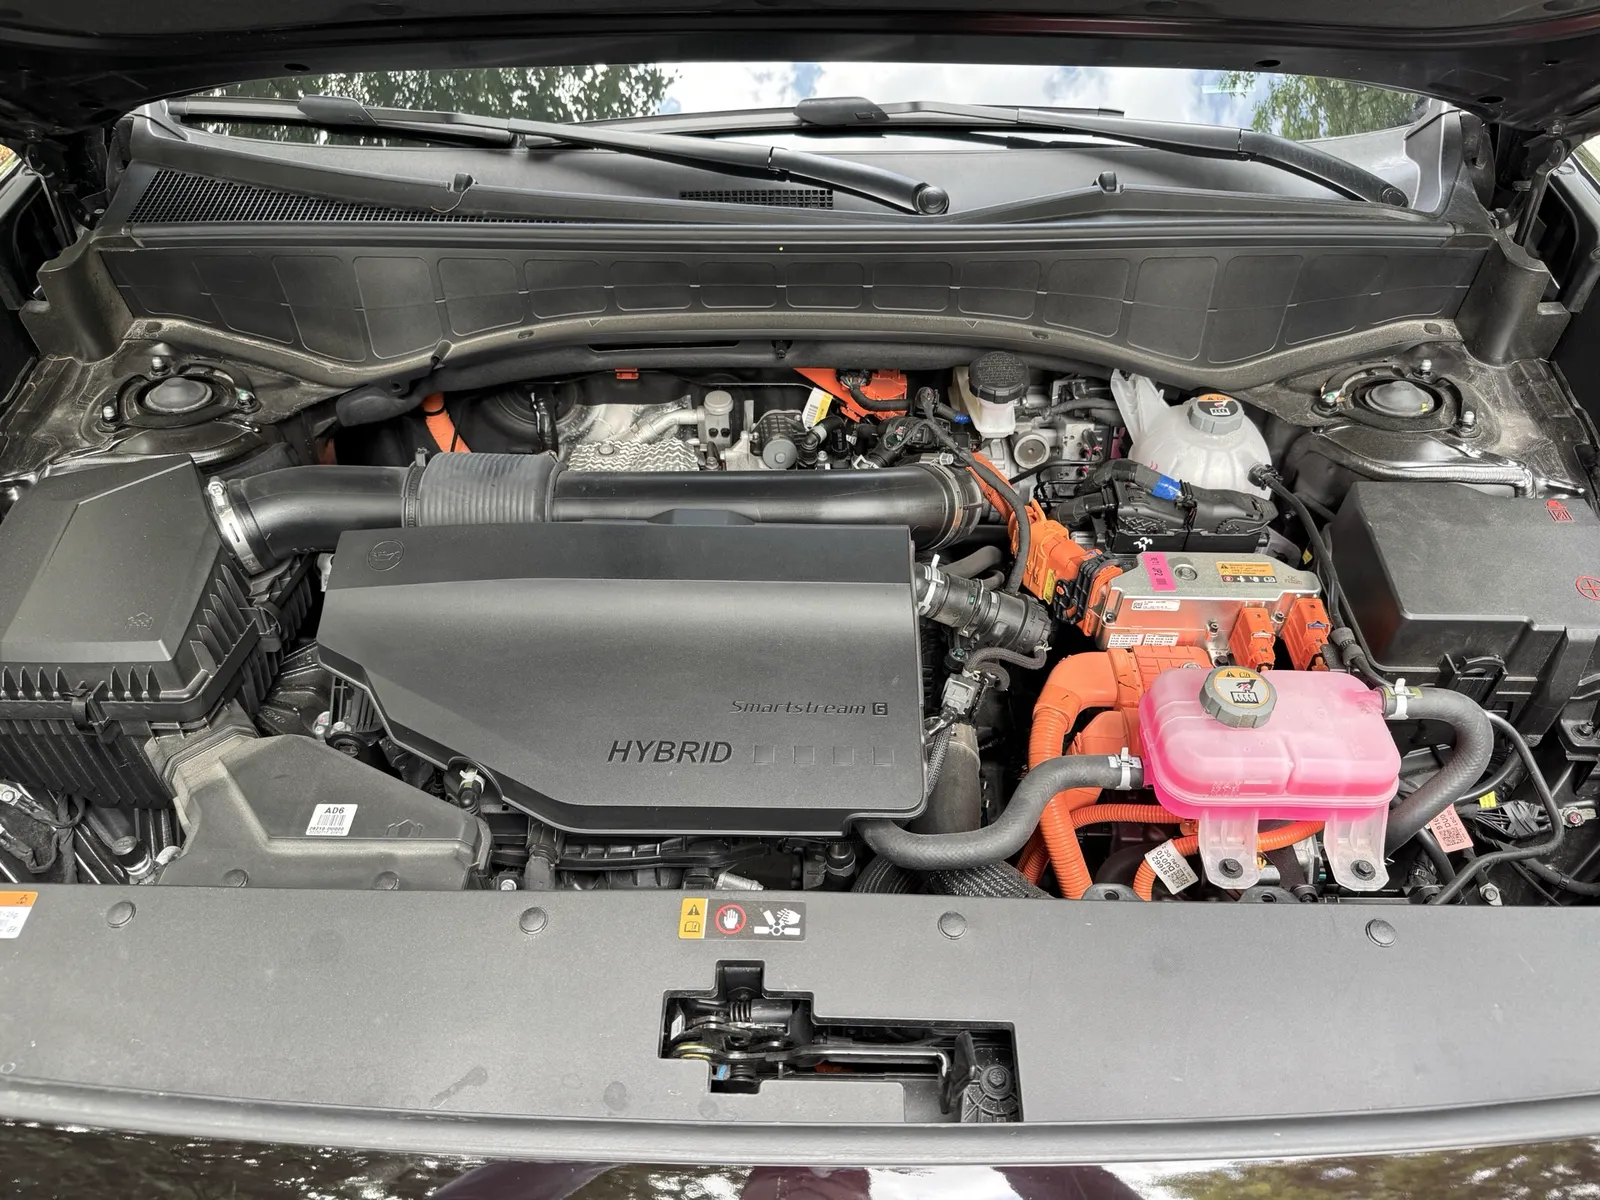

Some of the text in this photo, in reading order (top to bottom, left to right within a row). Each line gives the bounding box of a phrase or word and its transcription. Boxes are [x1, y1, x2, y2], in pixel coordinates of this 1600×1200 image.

[730, 700, 866, 715] Smartstream
[606, 740, 733, 764] HYBRID
[1156, 850, 1176, 872] DU010
